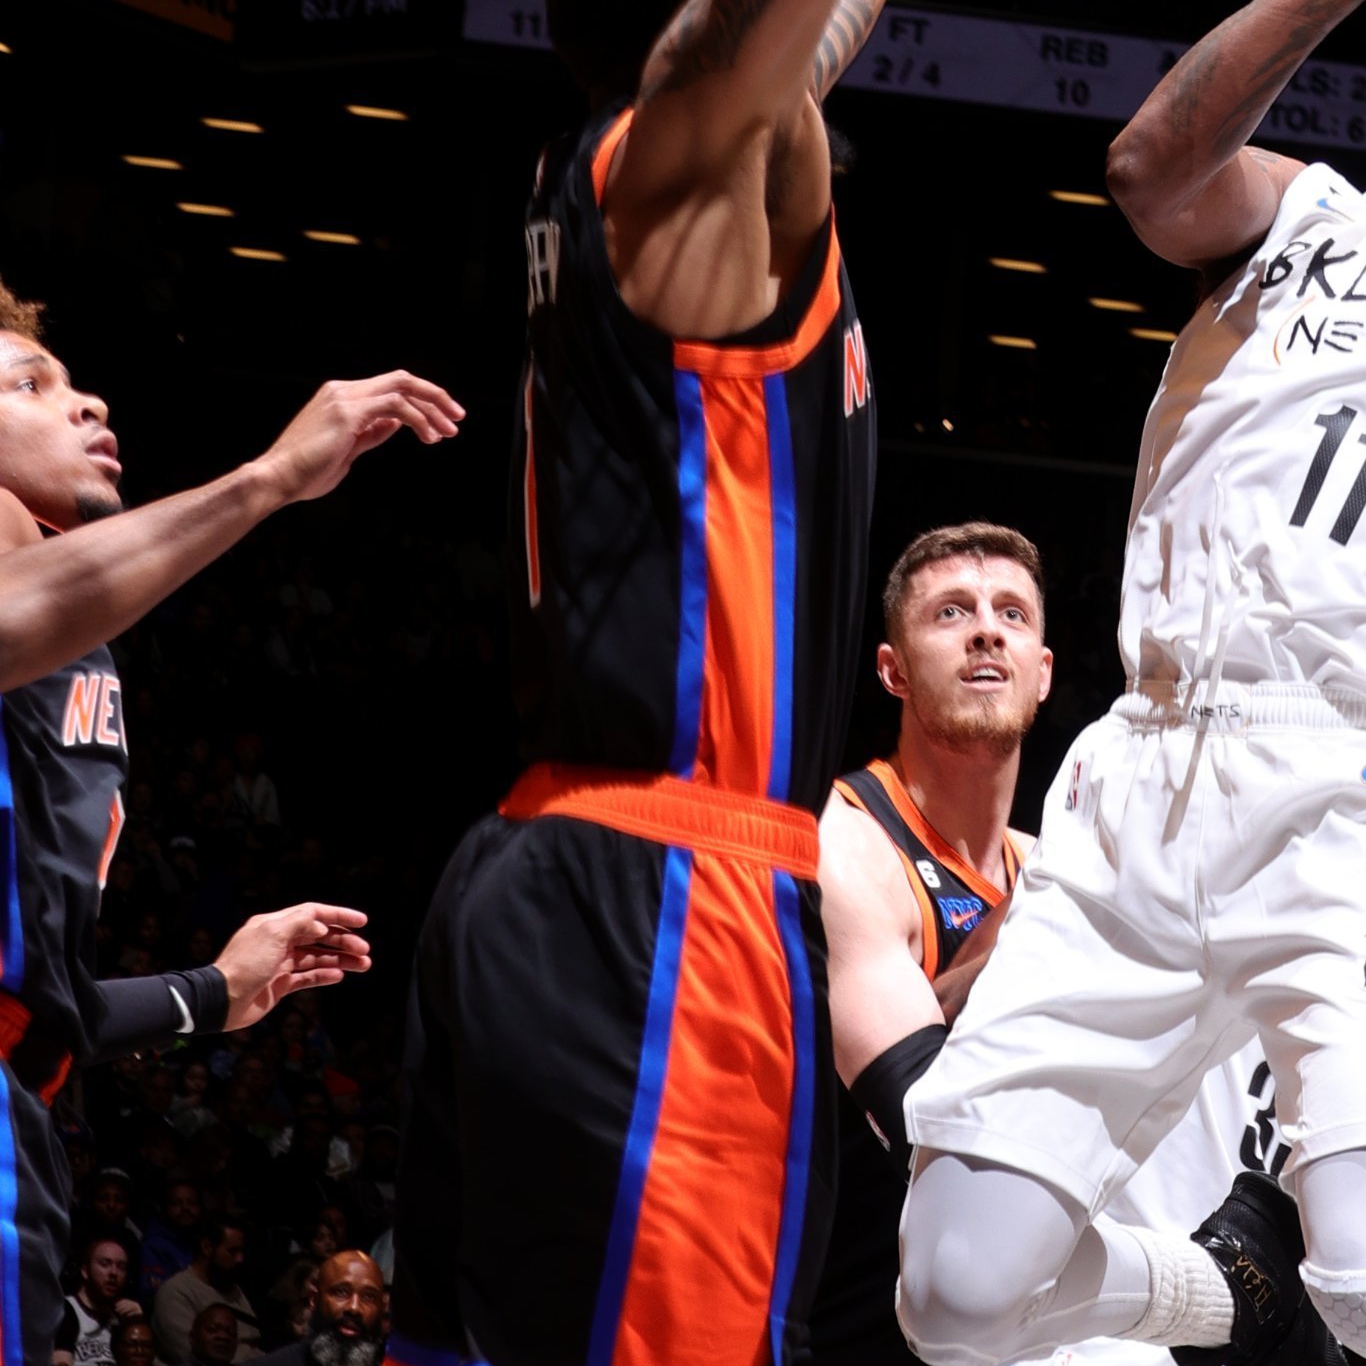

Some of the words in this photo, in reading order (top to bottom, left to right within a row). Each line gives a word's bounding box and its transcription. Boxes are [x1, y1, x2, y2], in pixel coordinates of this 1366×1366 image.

[888, 15, 931, 46] FT
[1040, 35, 1110, 68] REB
[1055, 78, 1091, 106] 10
[1289, 67, 1343, 100] LS:
[62, 671, 128, 757] NE
